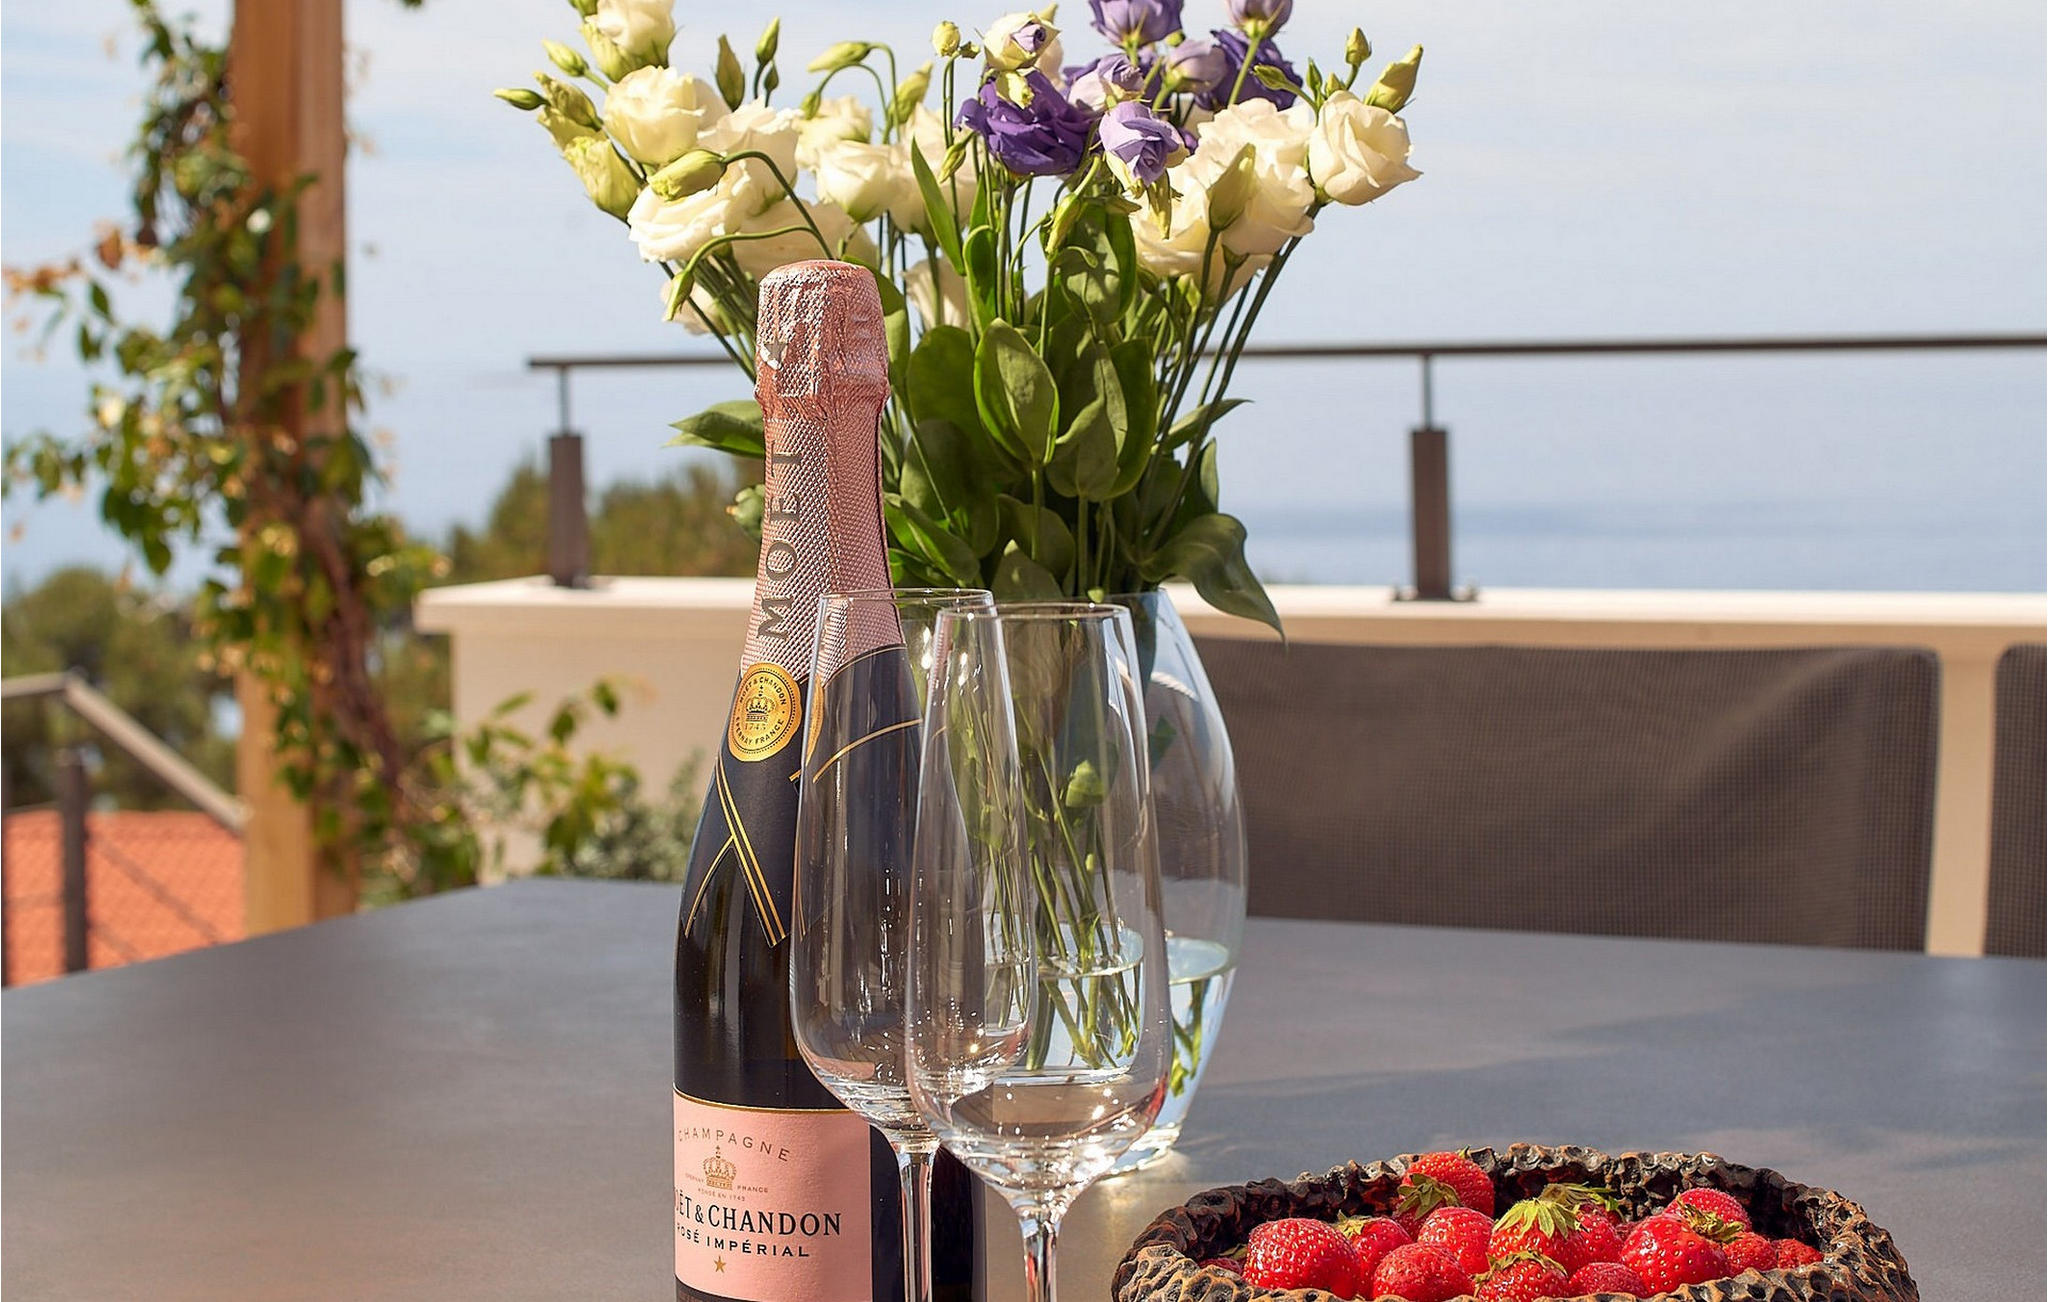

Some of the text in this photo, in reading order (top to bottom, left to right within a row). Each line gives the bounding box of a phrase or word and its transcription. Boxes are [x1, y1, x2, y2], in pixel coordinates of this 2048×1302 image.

[759, 676, 788, 707] CHANDON
[755, 718, 785, 746] FRANCE
[678, 1127, 790, 1162] CHAMPAGNE
[737, 1184, 769, 1194] FRANCE
[695, 1204, 704, 1224] &
[708, 1204, 842, 1237] CHANDON
[706, 1236, 810, 1257] IMPÉRIAL
